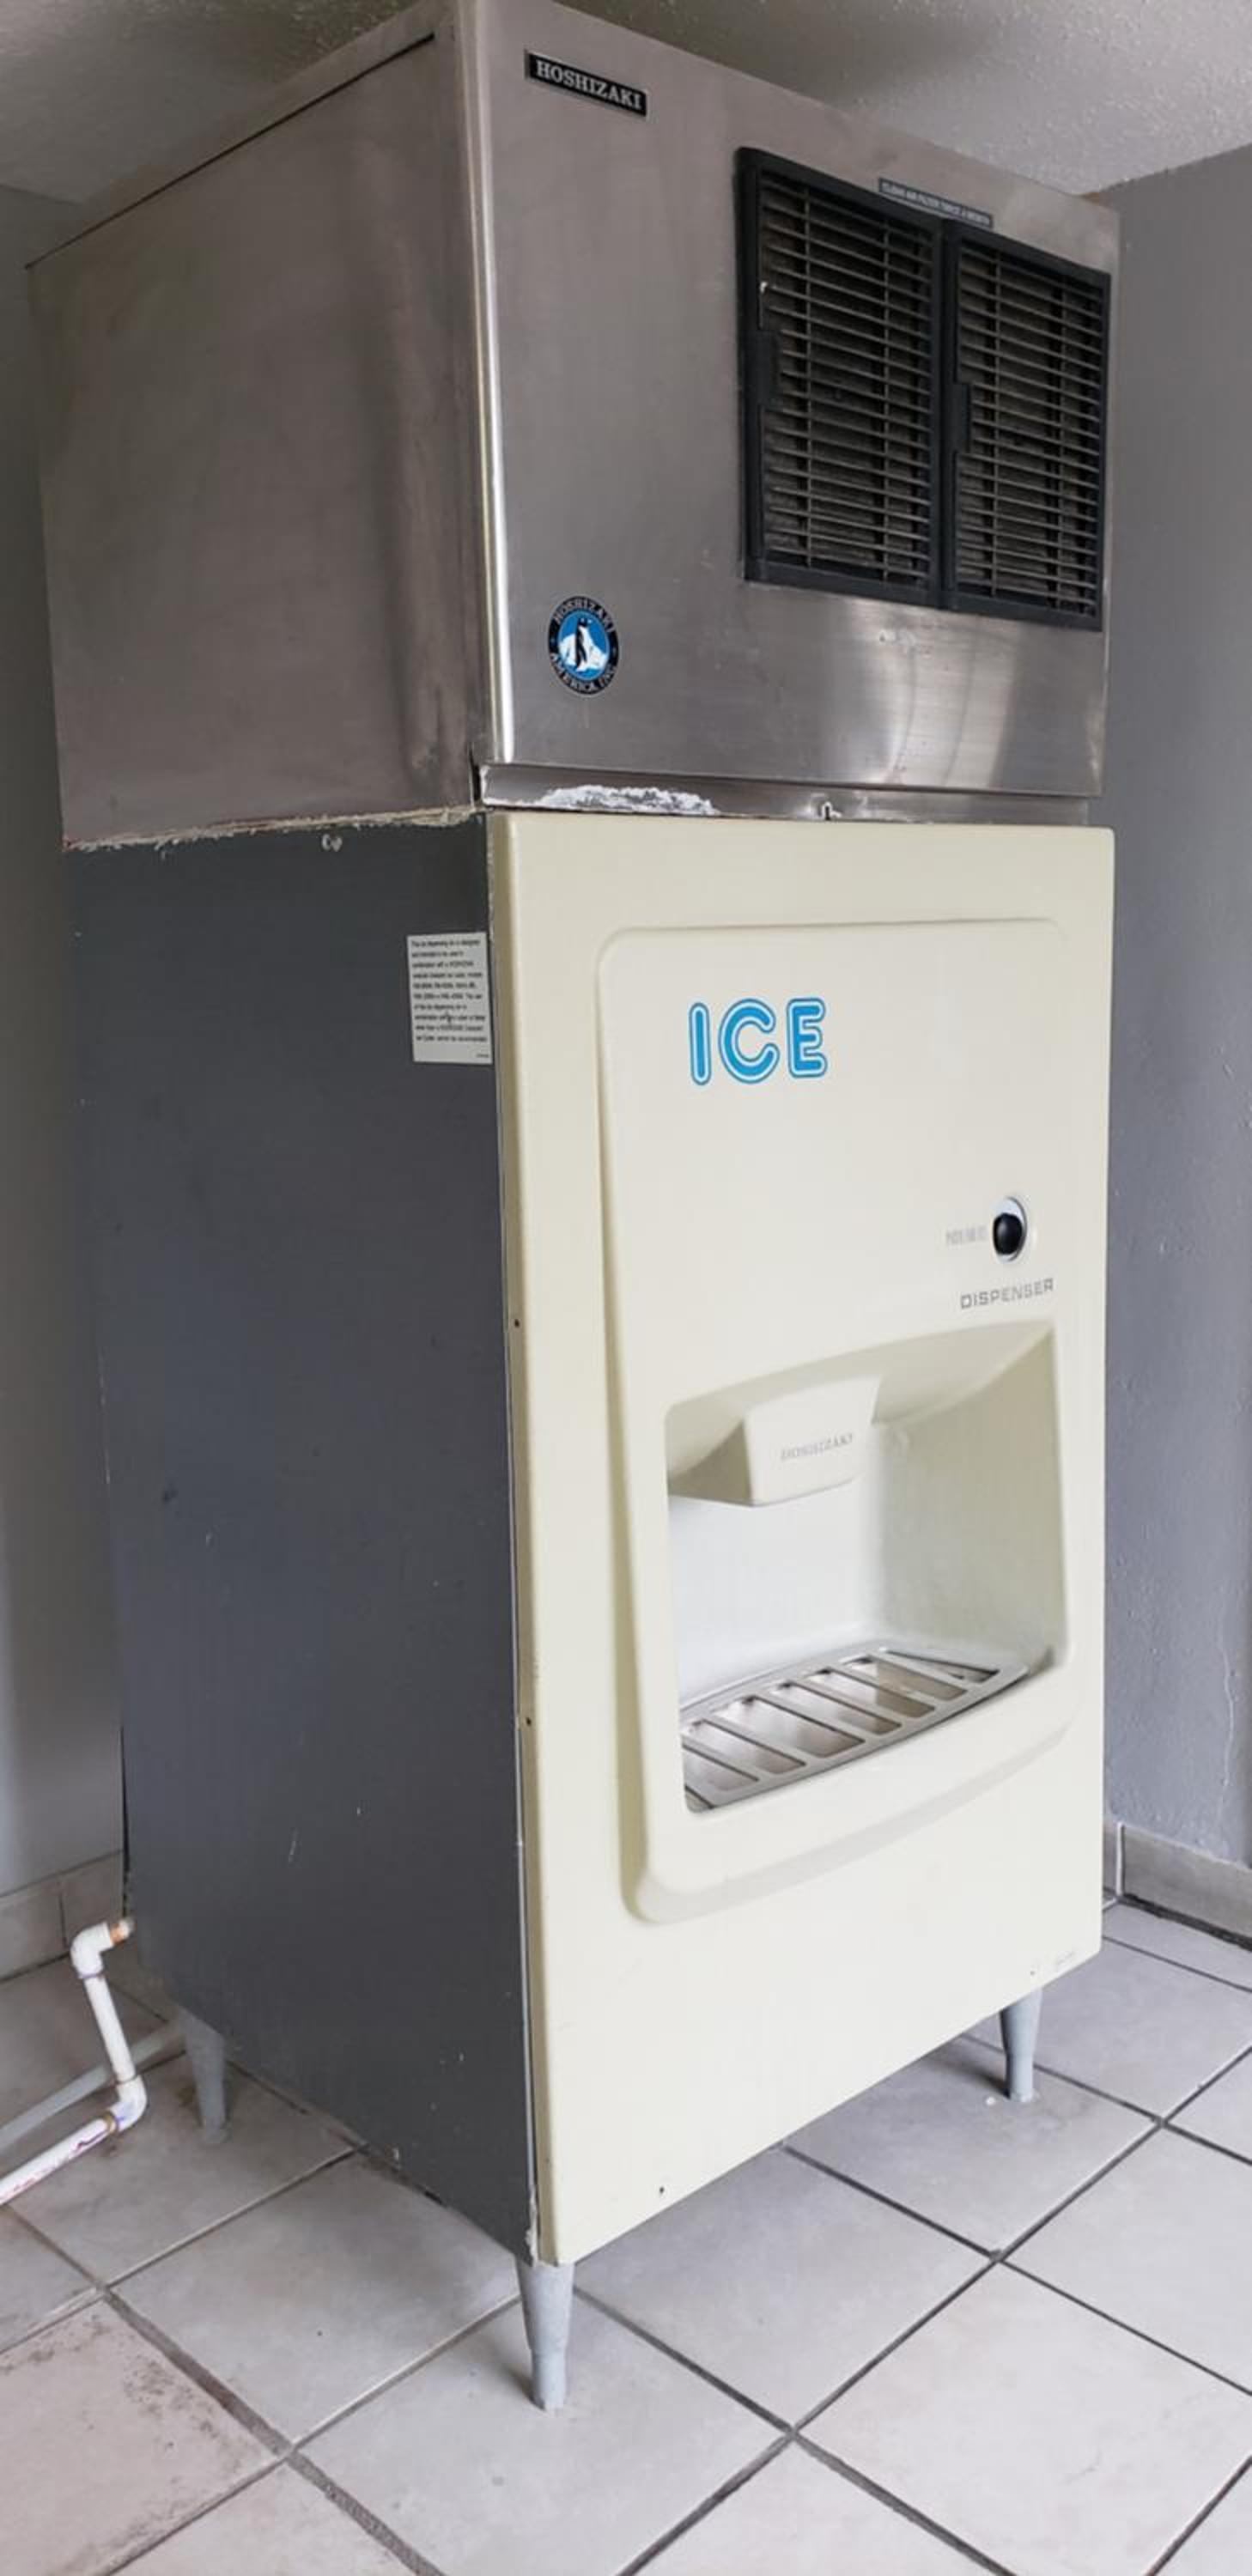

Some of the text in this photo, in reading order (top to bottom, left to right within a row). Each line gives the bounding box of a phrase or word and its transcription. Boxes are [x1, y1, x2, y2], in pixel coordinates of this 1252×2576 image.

[536, 59, 642, 110] HOSHIZAKI
[553, 599, 616, 634] HOSHIZAKI
[689, 999, 828, 1085] ICE
[960, 1278, 1054, 1309] DISPENSER
